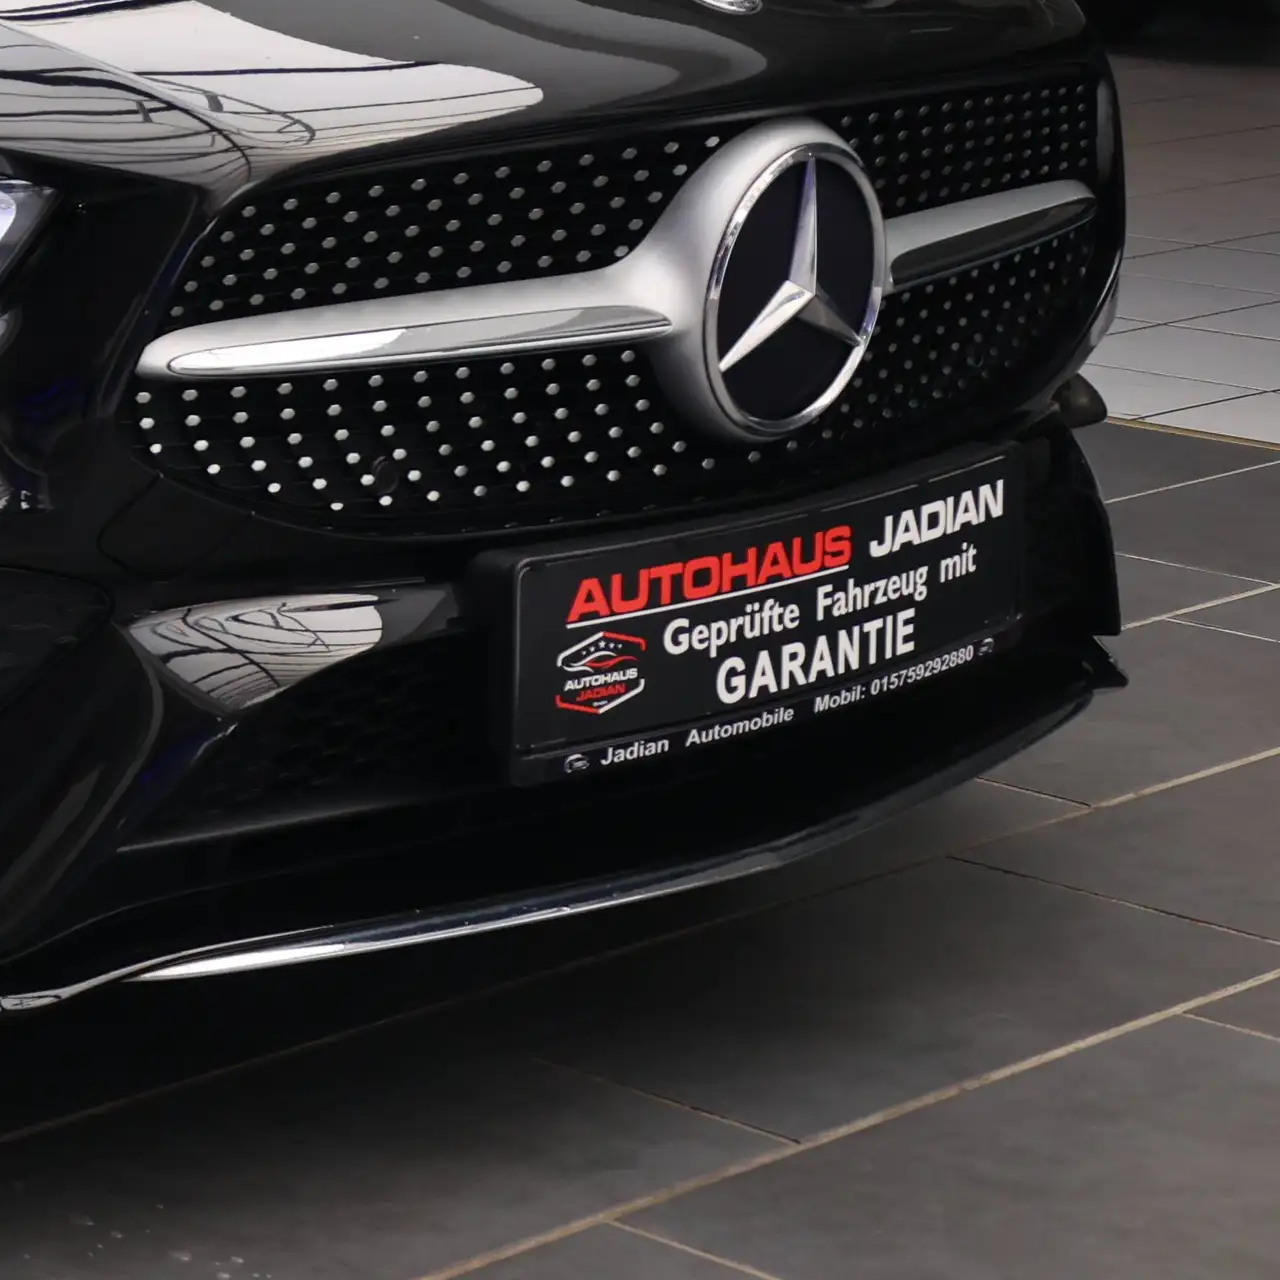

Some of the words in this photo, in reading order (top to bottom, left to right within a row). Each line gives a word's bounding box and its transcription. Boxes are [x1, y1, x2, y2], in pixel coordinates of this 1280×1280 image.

[567, 524, 852, 623] AUTOHAUS
[869, 479, 1004, 558] JADIAN
[663, 598, 800, 658] Geprüfte
[816, 565, 928, 621] Fahrzeug
[940, 541, 977, 583] mit
[564, 668, 638, 692] AUTOHAUS
[576, 683, 627, 702] JADIAN
[600, 738, 669, 767] Jadian
[685, 707, 795, 748] Automobile
[813, 685, 866, 713] Mobil:
[870, 644, 974, 695] 015759292880
[716, 607, 916, 705] GARANTIE
